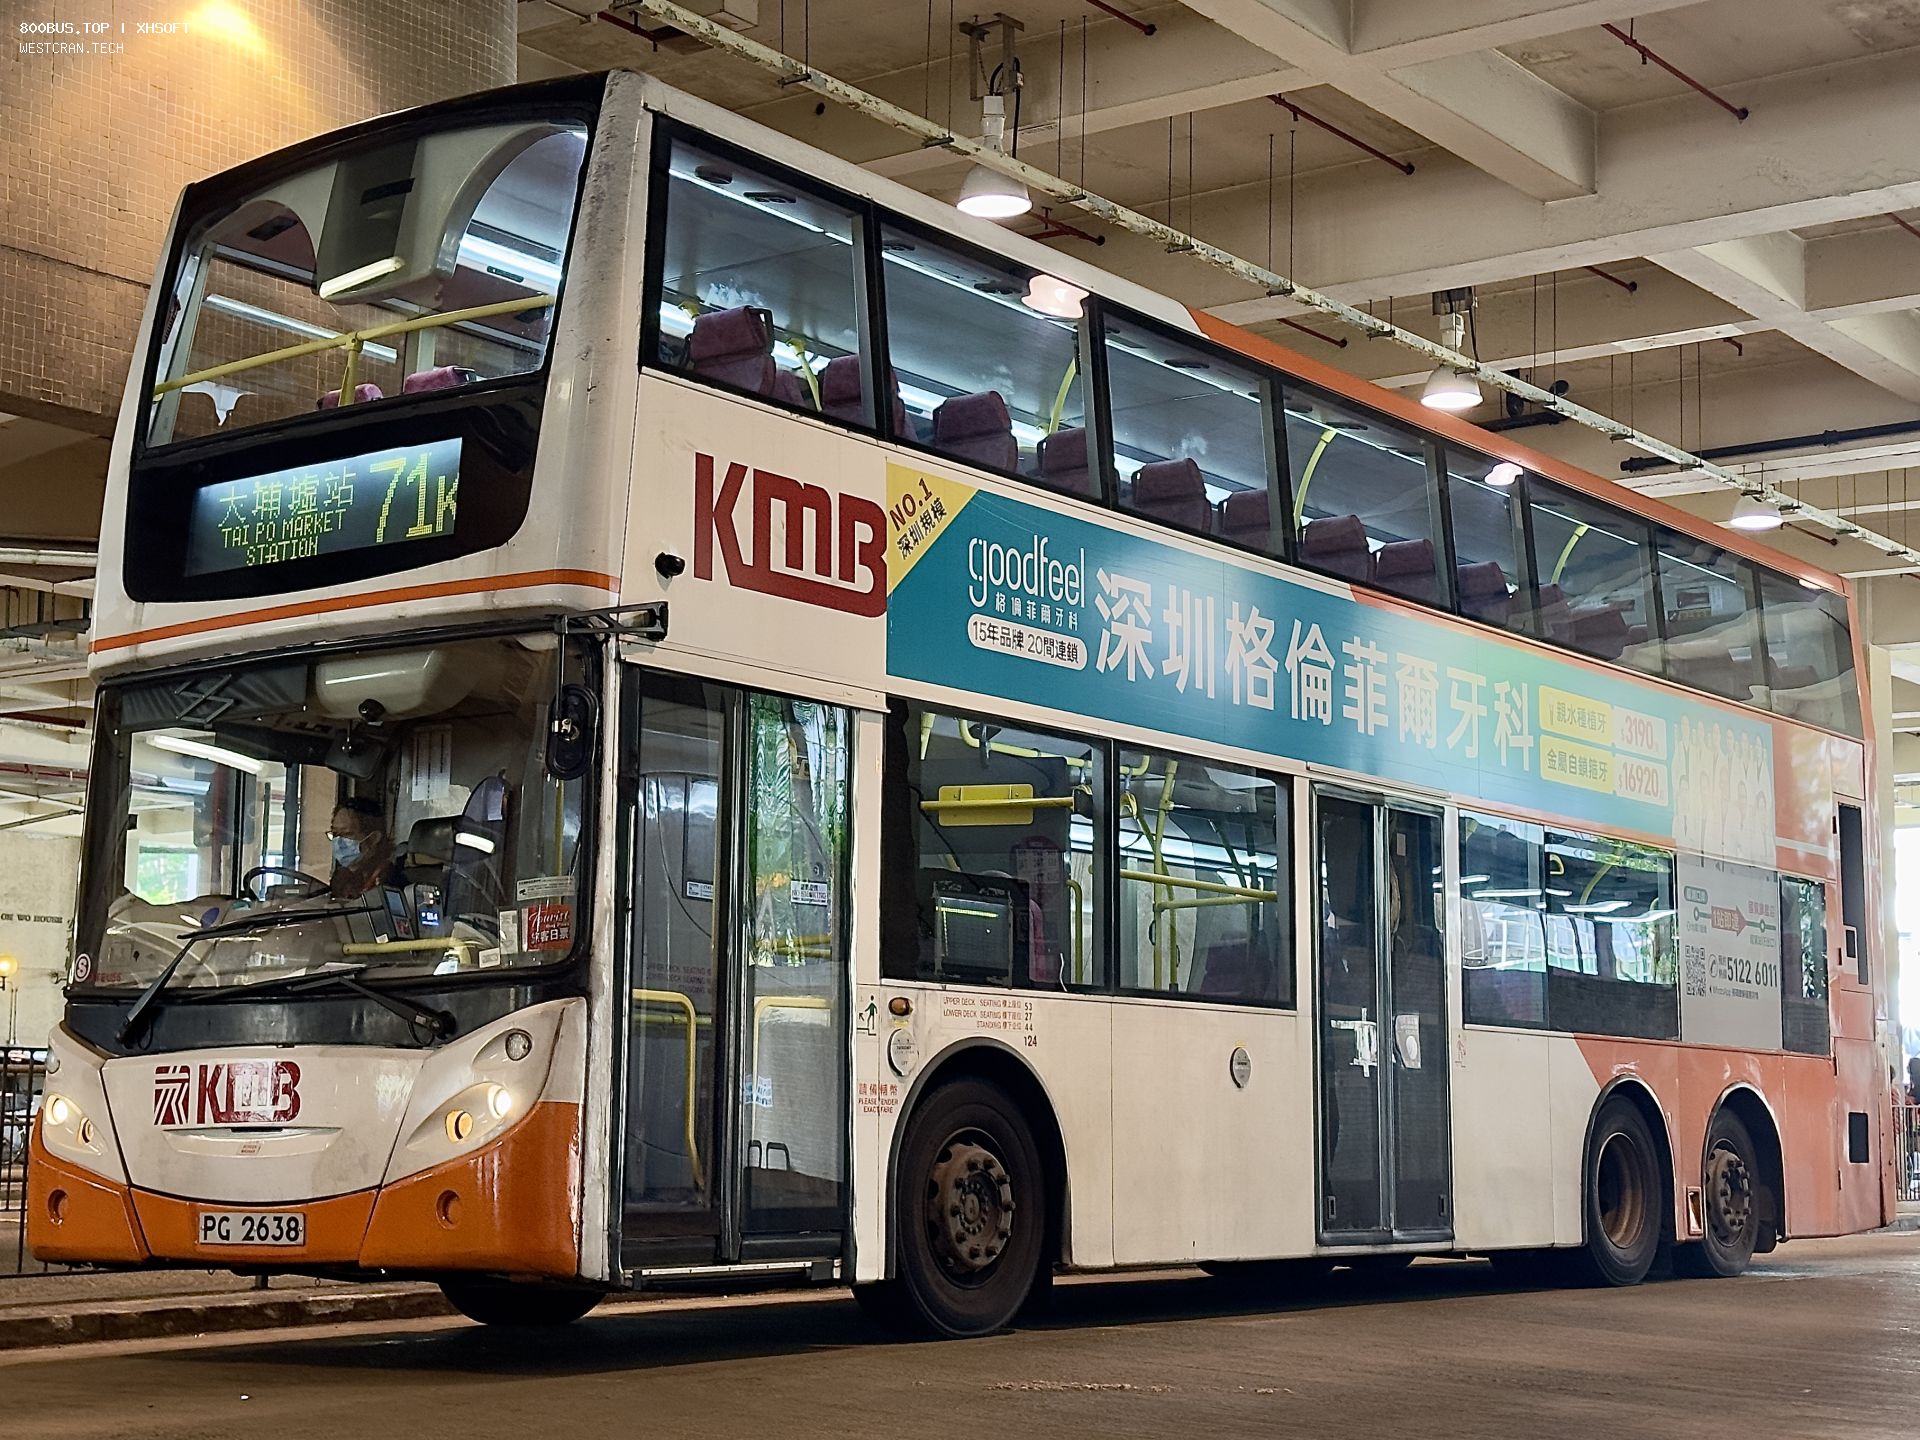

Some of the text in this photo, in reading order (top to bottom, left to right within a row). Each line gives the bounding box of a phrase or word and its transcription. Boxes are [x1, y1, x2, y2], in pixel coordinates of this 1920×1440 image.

[218, 466, 357, 527] 大埔墟站
[369, 451, 460, 543] 71K
[889, 477, 933, 532] NO.1
[221, 508, 347, 548] TAI PO MARKET
[693, 452, 887, 618] KMB
[897, 496, 947, 560] 深圳規模
[246, 536, 319, 566] STATION
[968, 534, 1085, 608] goodfeel
[995, 591, 1078, 632] 格倫菲爾牙科
[972, 620, 1079, 664] 15年品牌 20間連鎖
[1094, 567, 1535, 772] 深圳格倫菲爾牙科
[1727, 956, 1778, 988] 5122 6011
[943, 996, 961, 1005] UPPER
[962, 997, 976, 1006] DECK
[980, 998, 1001, 1008] SEATING
[1024, 1002, 1033, 1011] 53
[943, 1009, 962, 1018] LOWER
[963, 1010, 977, 1018] DECK
[980, 1010, 1001, 1020] SEATING
[1024, 1012, 1033, 1021] 27
[976, 1020, 1001, 1030] STANDING
[1024, 1023, 1033, 1031] 44
[1023, 1035, 1037, 1047] 124
[197, 1061, 301, 1125] KMB
[858, 1097, 877, 1105] PLEASE
[863, 1105, 894, 1114] EXACT FARE
[203, 1215, 300, 1242] PG 2638
